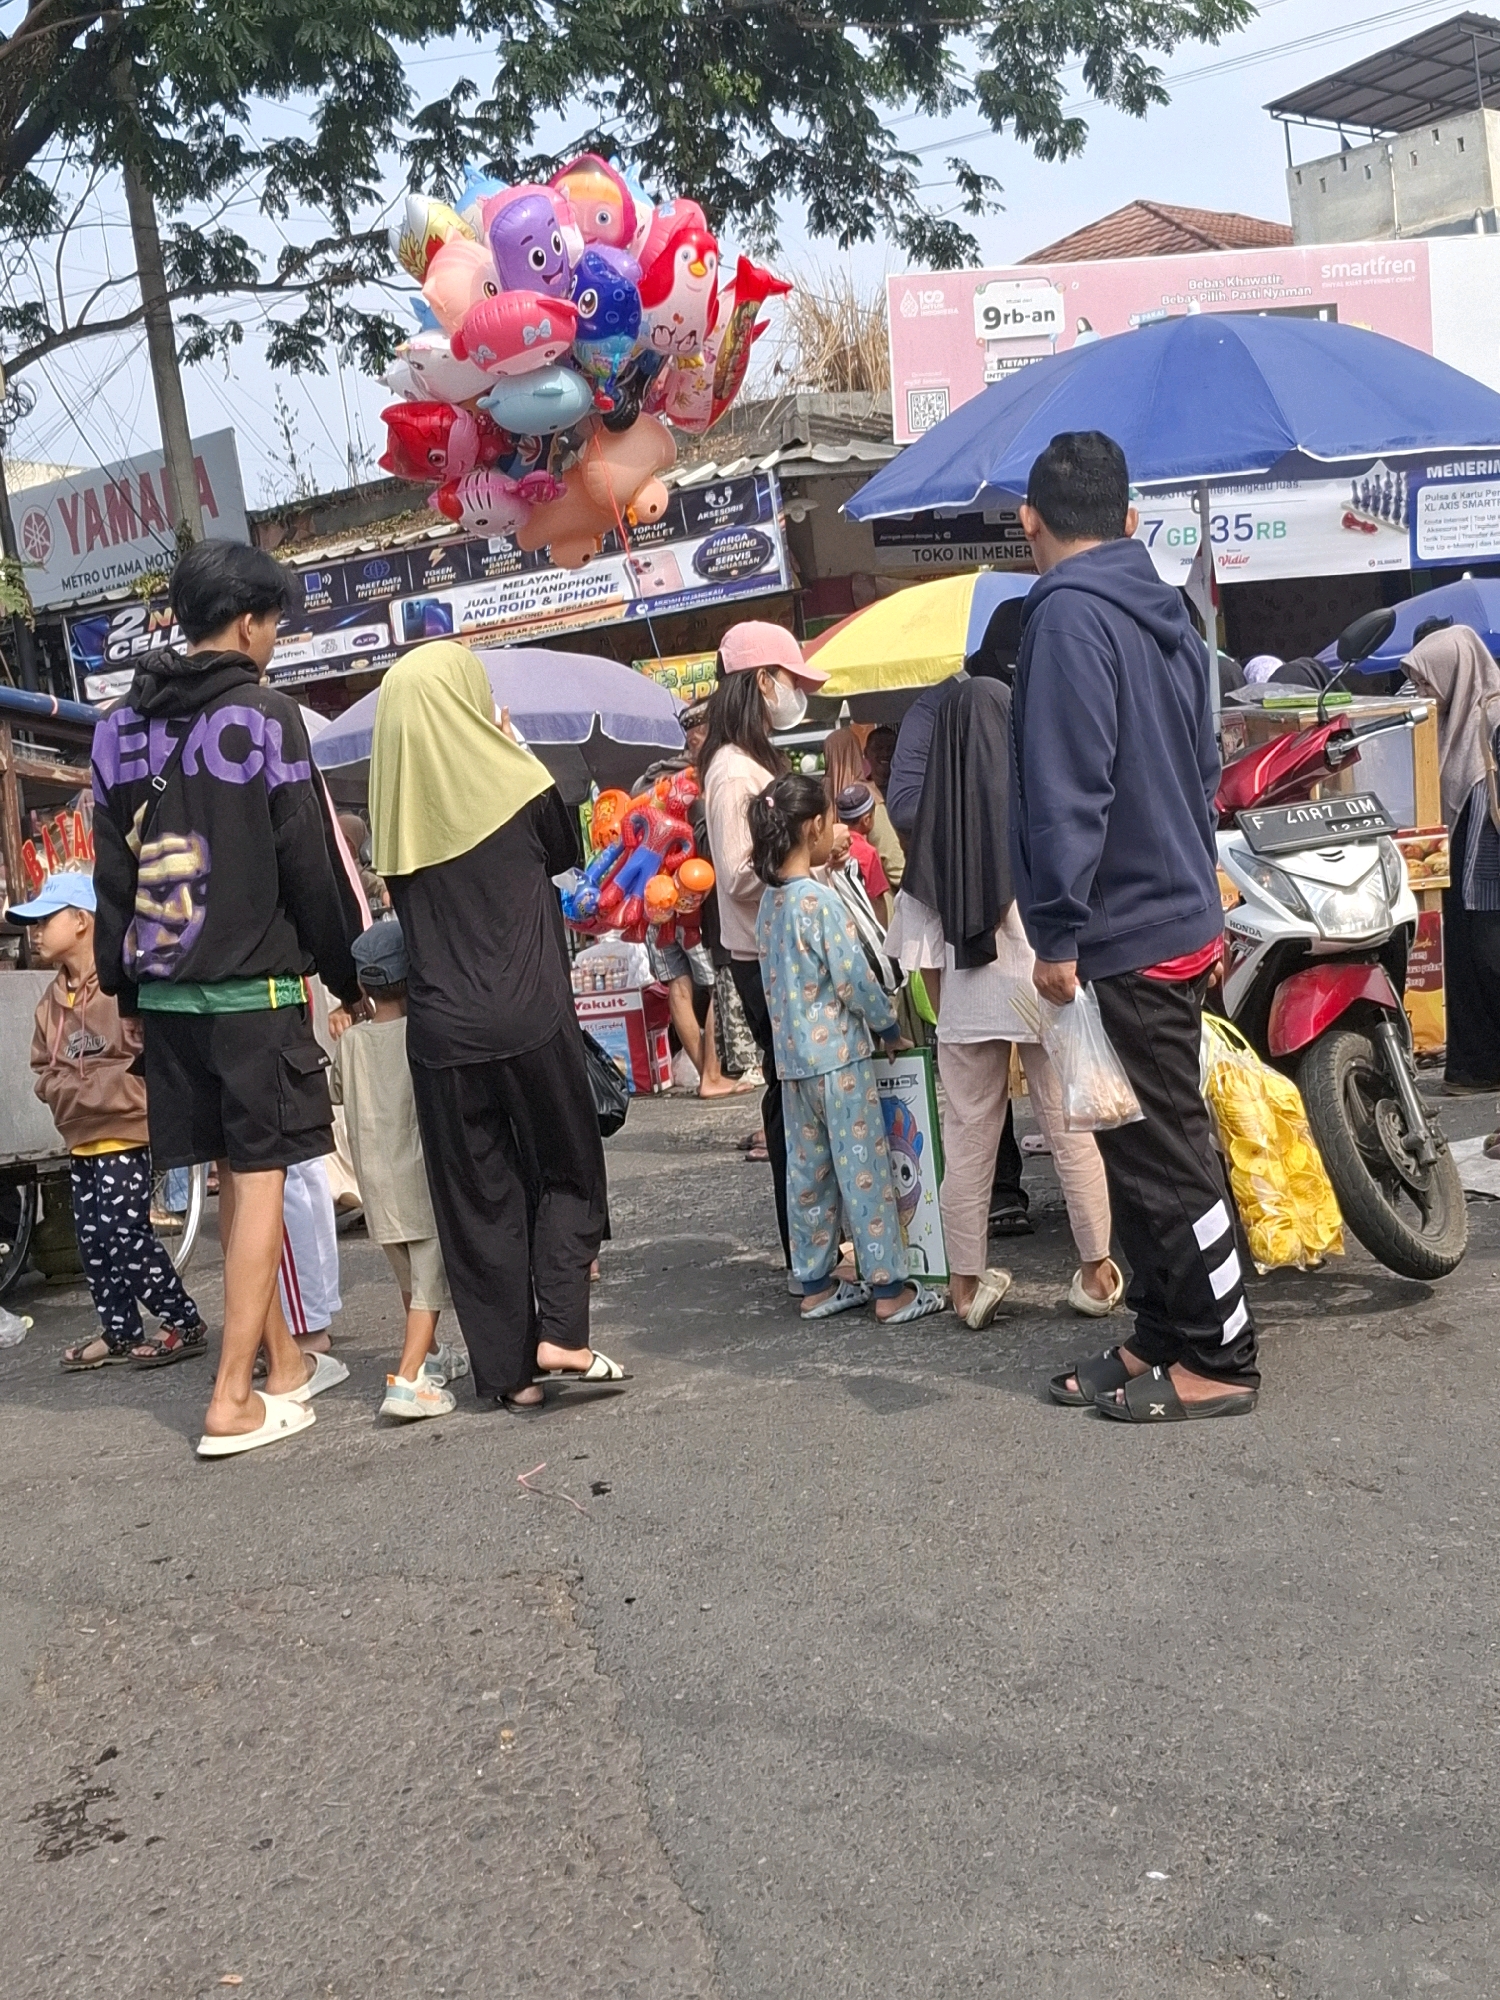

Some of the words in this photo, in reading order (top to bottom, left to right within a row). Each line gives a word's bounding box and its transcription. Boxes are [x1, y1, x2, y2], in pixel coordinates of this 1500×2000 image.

[1321, 256, 1416, 278] smartfren
[1188, 279, 1225, 290] Bebas
[1161, 294, 1197, 306] Bebas
[1231, 288, 1261, 300] Pasti
[1263, 286, 1312, 299] Nyaman
[1425, 493, 1449, 502] Pulsa
[1451, 492, 1457, 500] &
[1459, 491, 1483, 499] Kartu
[697, 503, 744, 521] AKSESORIS
[1424, 503, 1436, 512] XL
[1438, 501, 1460, 511] AXIS
[714, 515, 729, 525] HP
[633, 522, 667, 535] TOP-UP
[1143, 519, 1164, 548] 7
[1166, 526, 1198, 547] GB
[1210, 513, 1254, 544] 35
[1256, 520, 1287, 541] RB
[706, 539, 757, 557] BERSAING
[712, 533, 749, 547] HARGA
[481, 550, 522, 565] MELAYANI
[715, 551, 751, 565] SERVIS
[911, 548, 954, 564] TOKO
[958, 547, 978, 561] INI
[1217, 553, 1251, 568] Vidio
[61, 570, 100, 592] METRO
[102, 558, 143, 581] UTAMA
[145, 548, 184, 572] MOTO
[425, 566, 453, 578] TOKEN
[484, 563, 522, 577] TAGIHAN
[355, 579, 380, 592] PAKET
[382, 576, 402, 587] DATA
[422, 572, 457, 585] LISTRIK
[502, 571, 564, 591] MELAYANI
[357, 584, 401, 599] INTERNET
[464, 597, 496, 609] JUAL
[500, 588, 526, 602] BELI
[530, 573, 612, 598] HANDPHONE
[462, 598, 537, 622] ANDROID
[541, 596, 552, 606] &
[508, 611, 544, 623] SECOND
[108, 606, 147, 645] 2
[108, 624, 187, 661] CELL
[355, 635, 378, 645] AXIS
[681, 660, 718, 686] JER
[1252, 816, 1265, 830] F
[1344, 798, 1377, 815] DM
[1229, 920, 1263, 938] HONDA
[574, 998, 628, 1011] Yakult
